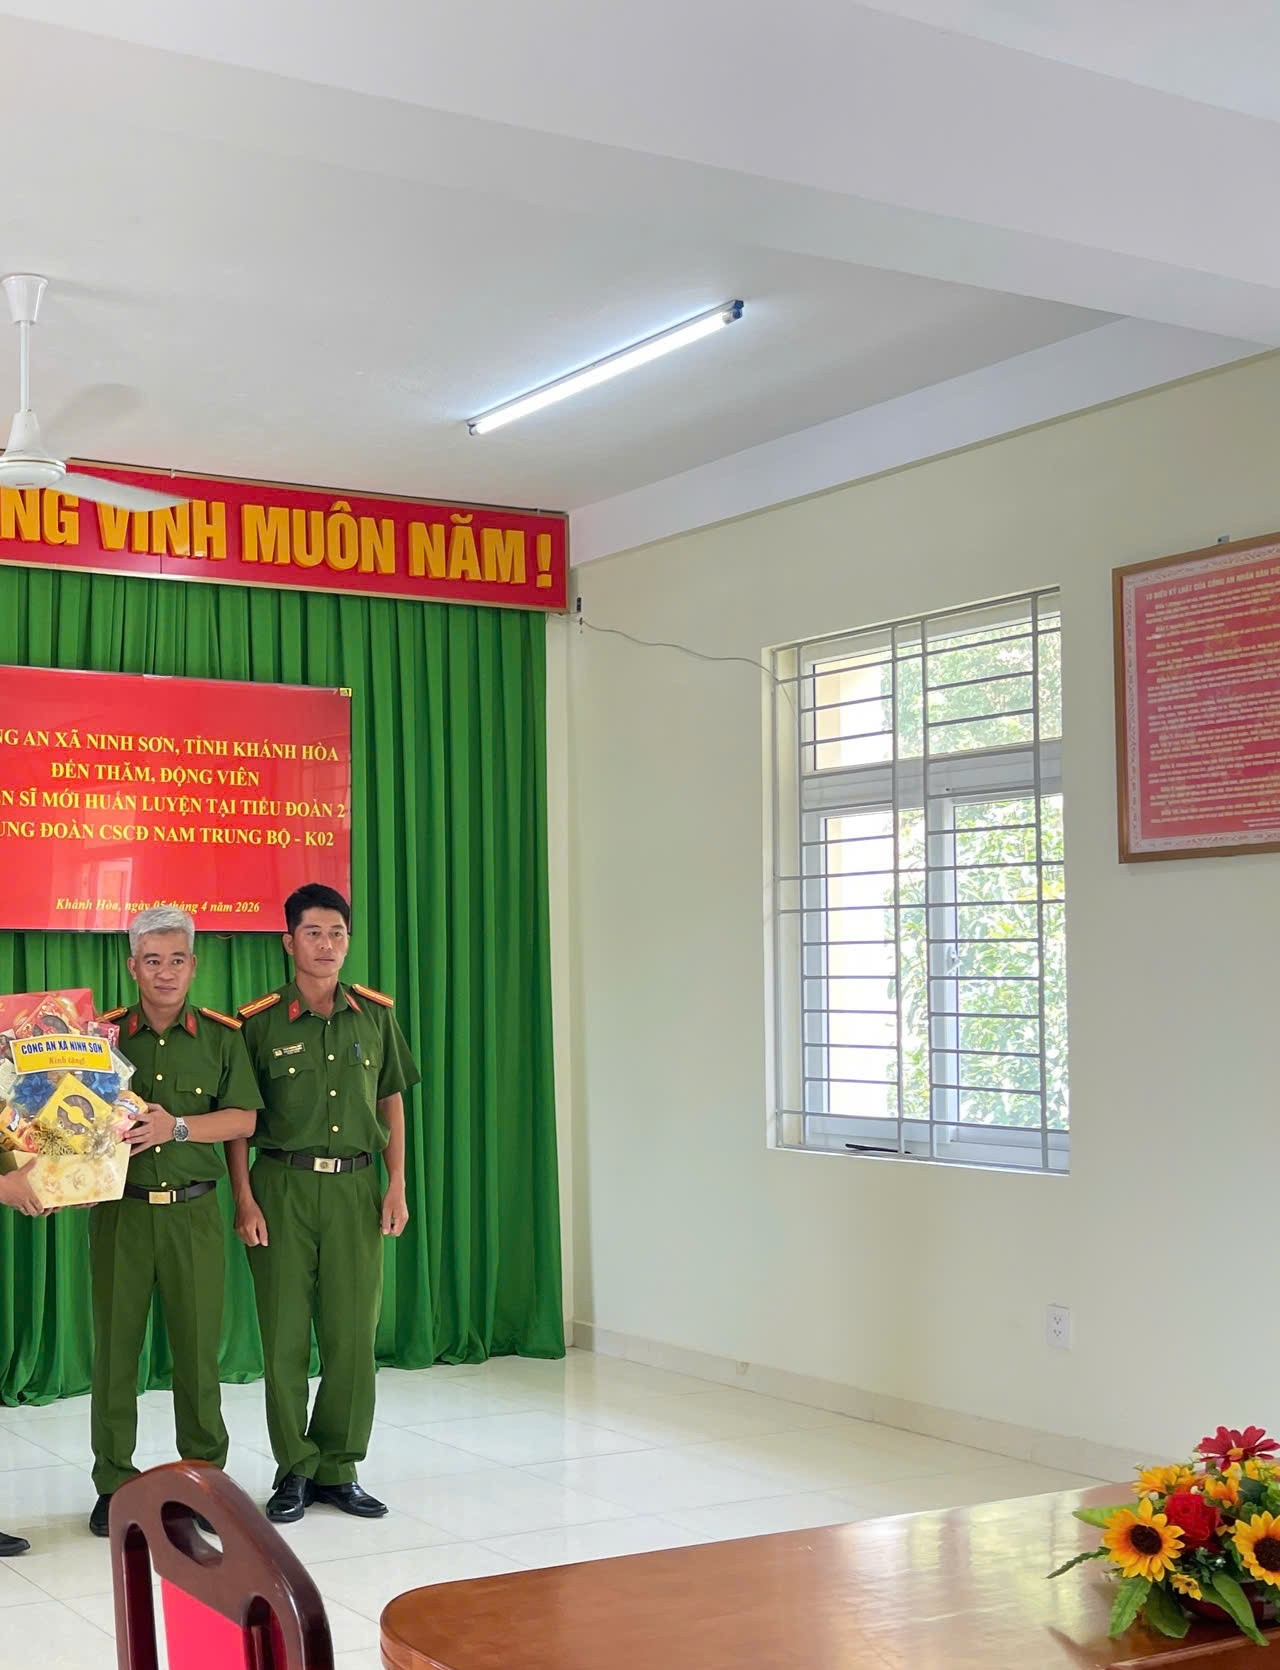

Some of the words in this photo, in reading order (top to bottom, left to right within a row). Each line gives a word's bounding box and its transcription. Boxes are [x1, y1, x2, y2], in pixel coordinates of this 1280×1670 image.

[96, 499, 226, 559] VINH
[242, 502, 396, 574] MUÔN
[408, 513, 526, 585] NĂM
[535, 531, 552, 588] !
[23, 731, 50, 747] AN
[55, 729, 81, 748] XÃ
[86, 734, 133, 751] NINH
[138, 736, 180, 754] SƠN,
[184, 735, 228, 756] TỈNH
[233, 739, 297, 759] KHÁNH
[302, 742, 340, 761] HÒA
[51, 759, 90, 780] ĐẾN
[95, 762, 156, 784] THĂM,
[160, 766, 212, 787] ĐỘNG
[217, 767, 260, 786] VIÊN
[19, 787, 37, 807] SĨ
[42, 789, 80, 809] MỚI
[85, 790, 137, 811] HUẤN
[142, 795, 202, 817] LUYỆN
[206, 798, 236, 818] TẠI
[240, 797, 281, 816] TIỂU
[285, 799, 333, 818] ĐOÀN
[336, 804, 346, 818] 2
[40, 819, 95, 839] ĐOÀN
[99, 824, 149, 841] CSCĐ
[153, 826, 195, 843] NAM
[200, 827, 262, 845] TRUNG
[266, 828, 291, 849] BỘ
[304, 831, 335, 847] K02
[56, 898, 93, 910] Khánh
[96, 899, 122, 913] Hòa,
[125, 900, 151, 913] ngày
[201, 901, 209, 912] 4
[210, 901, 234, 912] năm
[235, 901, 261, 913] 2026
[45, 1040, 57, 1052] AN
[69, 1041, 87, 1052] NINH
